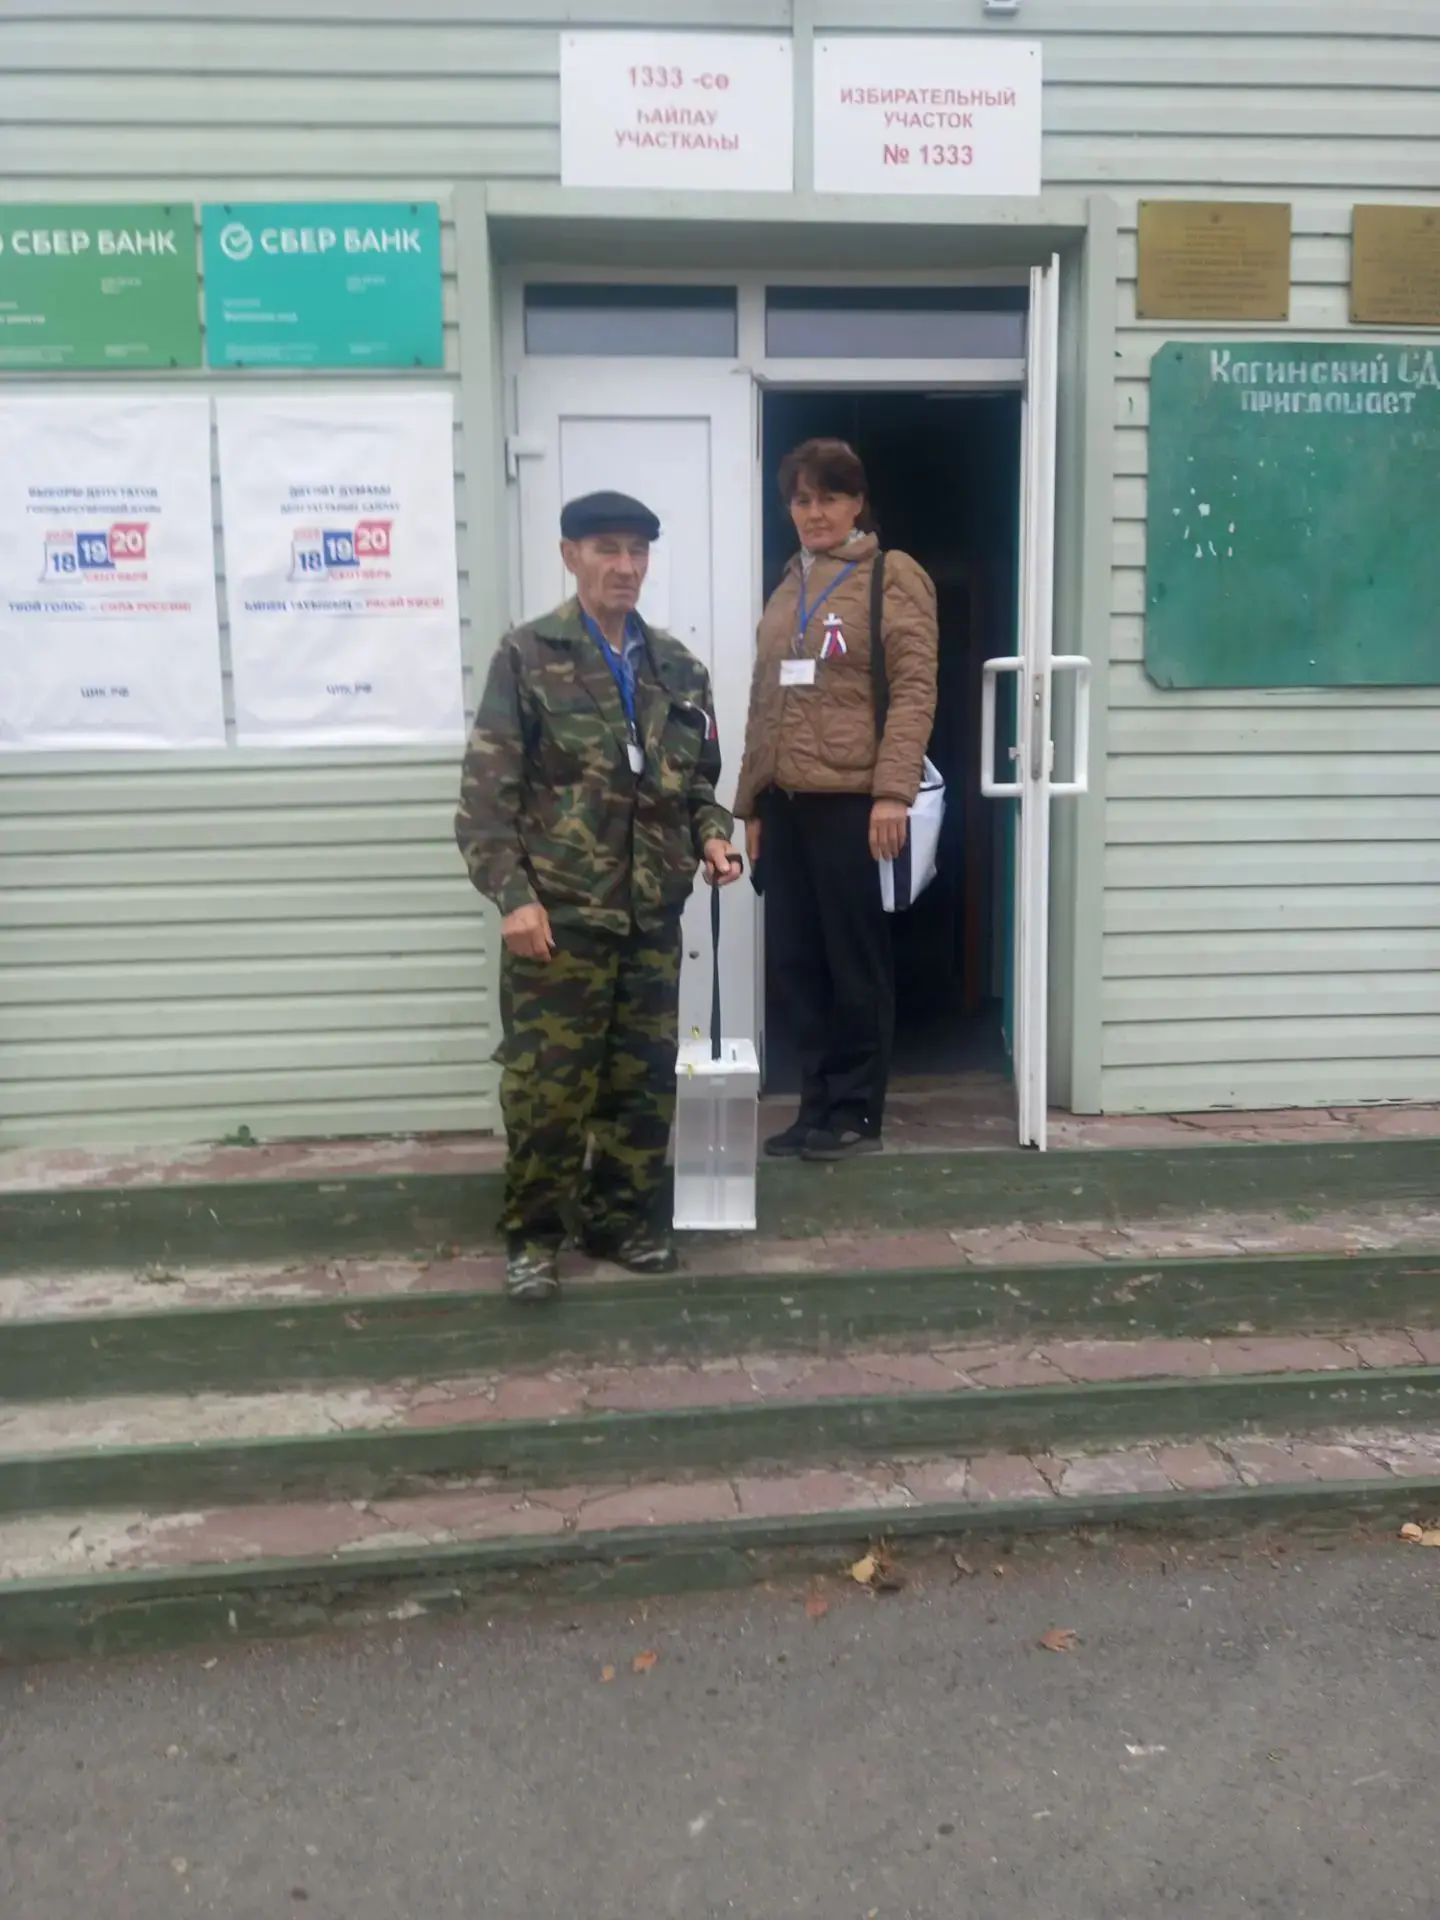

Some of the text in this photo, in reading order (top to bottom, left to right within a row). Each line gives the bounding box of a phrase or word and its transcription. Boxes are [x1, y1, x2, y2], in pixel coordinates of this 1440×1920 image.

[629, 66, 684, 89] 1333
[840, 87, 1016, 107] ИЗБИРАТЕЛЬНЫЙ
[884, 111, 973, 129] УЧАСТОК
[883, 143, 973, 166] № 1333
[11, 229, 177, 255] СБЕР БАНК
[260, 228, 421, 254] СБЕР БАНК
[1211, 349, 1388, 384] Кагинский
[52, 529, 143, 573] 18 19 20
[298, 527, 387, 572] 18 19 20
